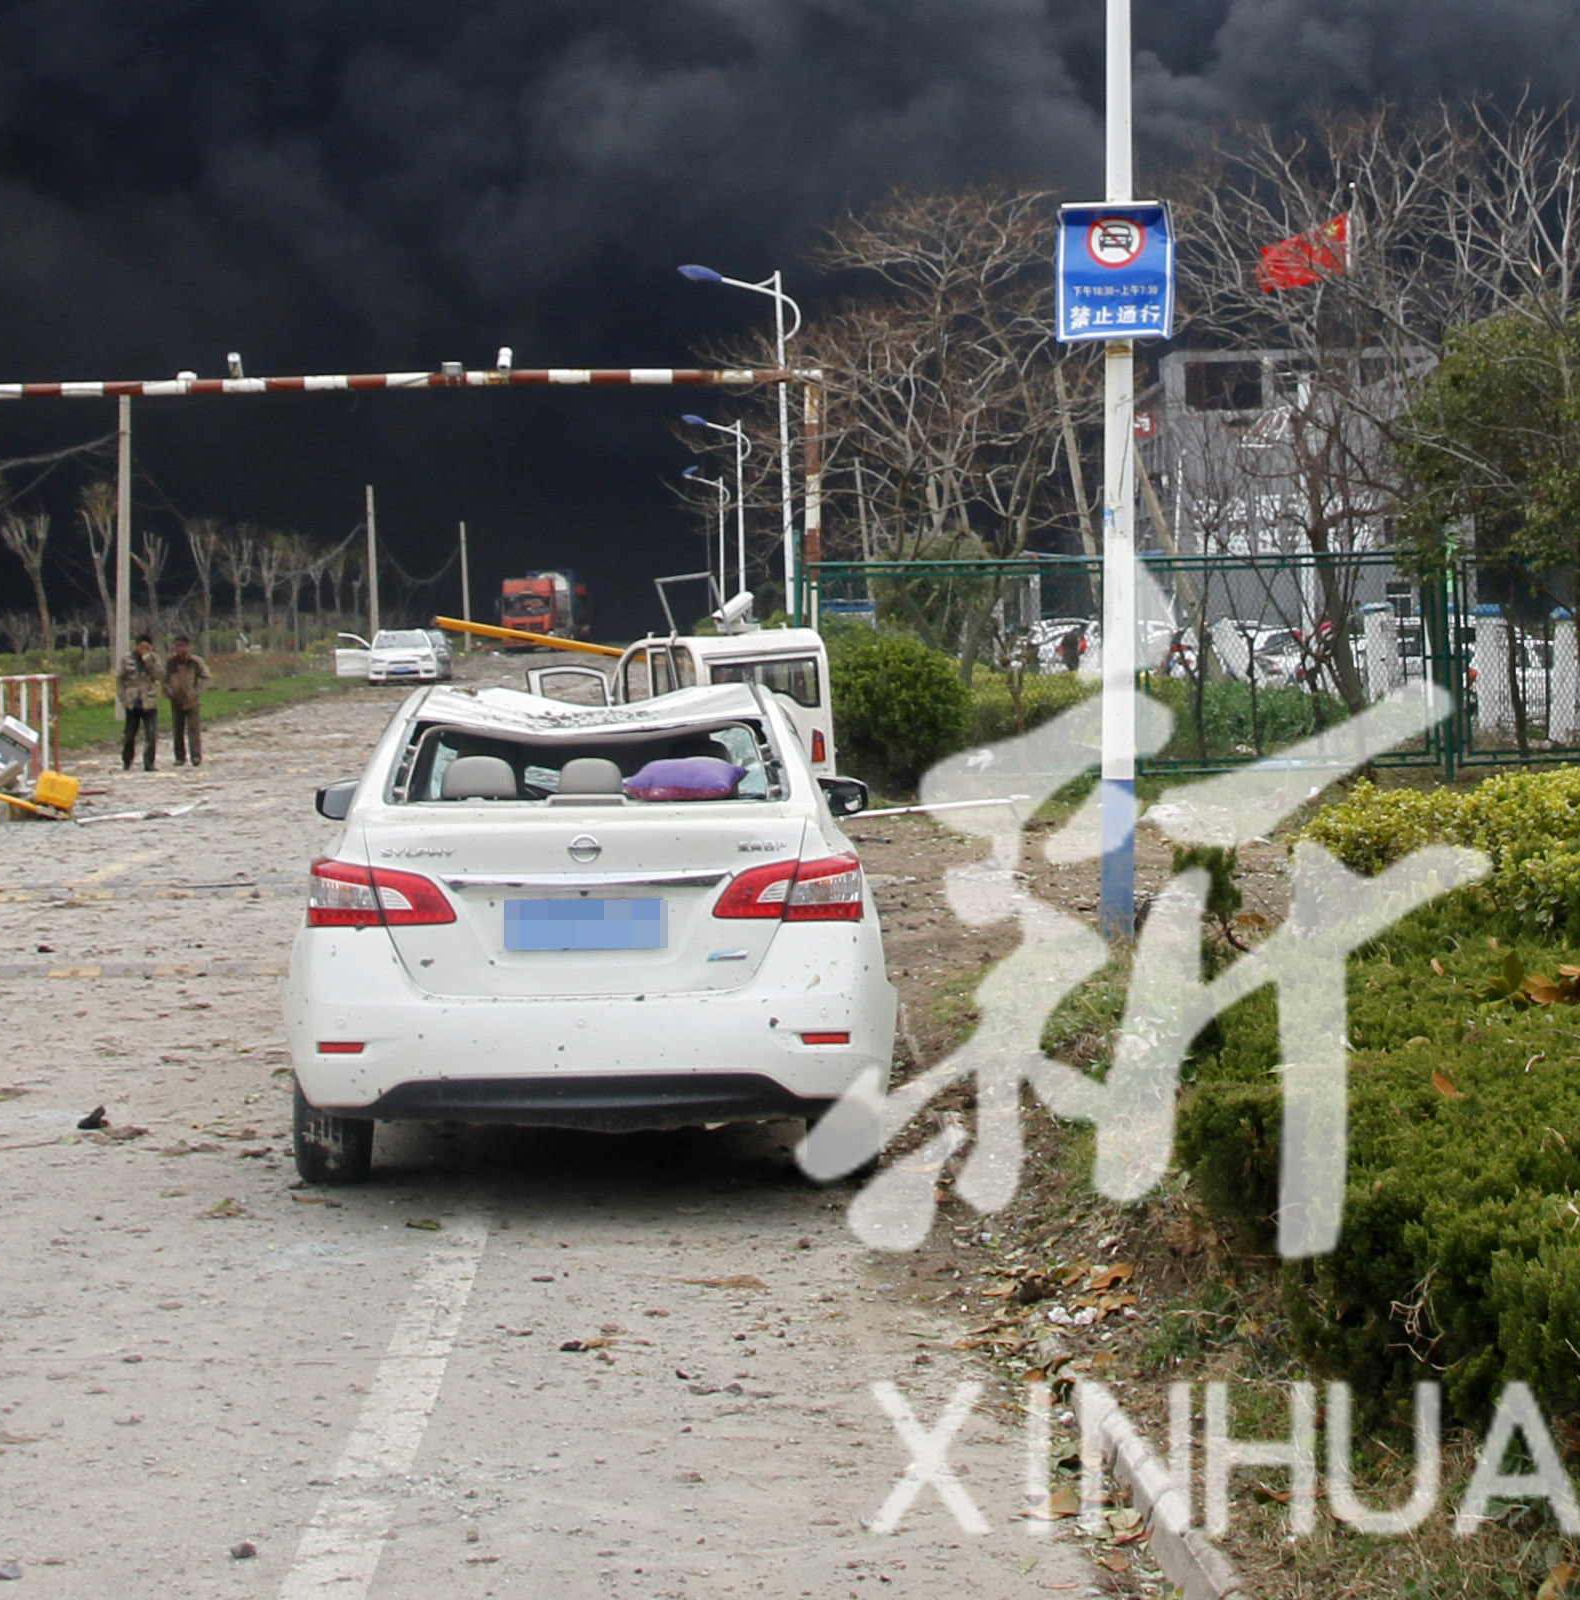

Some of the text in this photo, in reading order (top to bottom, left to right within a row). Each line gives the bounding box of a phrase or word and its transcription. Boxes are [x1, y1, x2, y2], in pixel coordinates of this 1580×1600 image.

[1070, 305, 1161, 330] 禁止通行
[380, 847, 456, 858] SYLPHY
